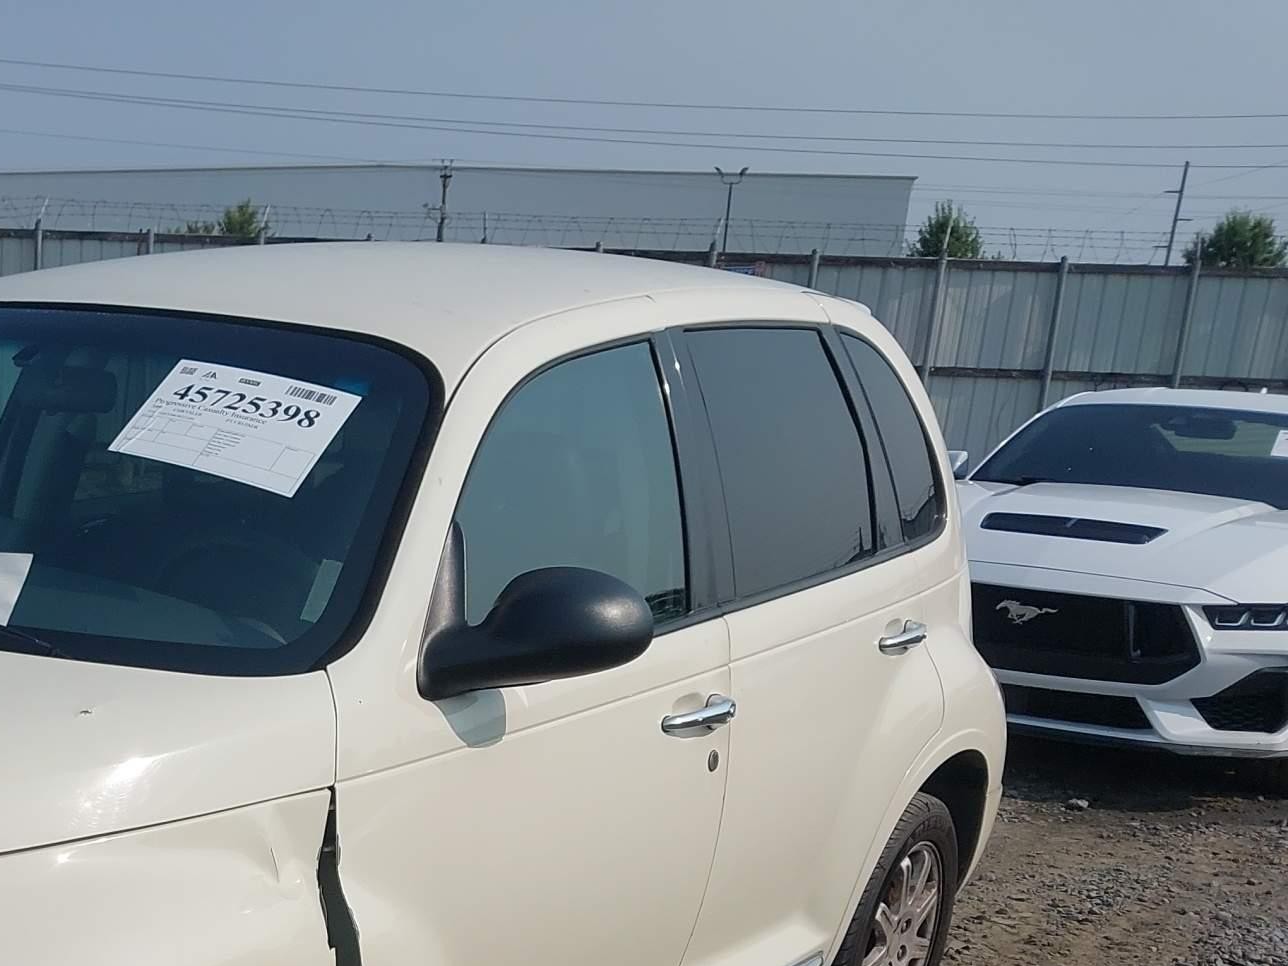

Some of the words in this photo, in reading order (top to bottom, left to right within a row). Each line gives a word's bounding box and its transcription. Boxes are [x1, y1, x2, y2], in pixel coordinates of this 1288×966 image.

[173, 383, 321, 428] 45725398
[198, 402, 230, 417] Casualty
[231, 411, 267, 424] Insurance
